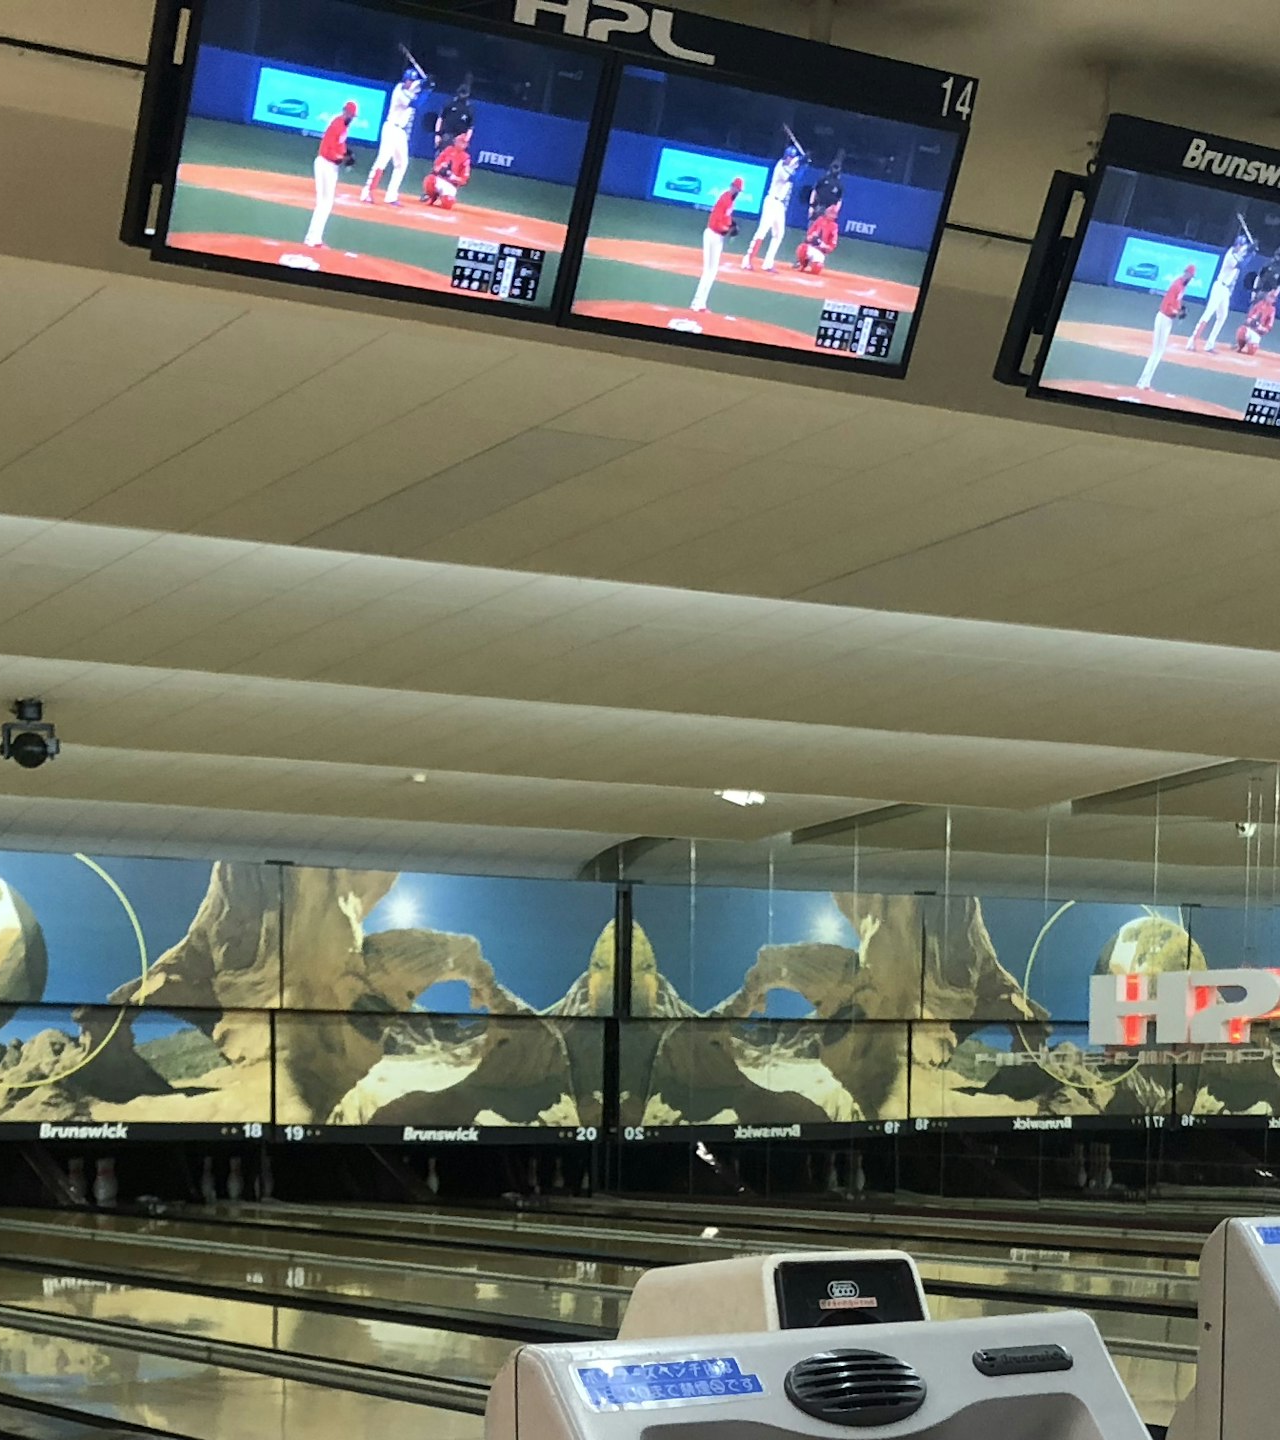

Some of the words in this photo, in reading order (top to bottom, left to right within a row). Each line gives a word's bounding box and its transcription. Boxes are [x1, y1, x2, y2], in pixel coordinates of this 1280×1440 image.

[514, 0, 715, 65] HPL
[940, 76, 974, 121] 14
[39, 1122, 128, 1140] Brunswick
[243, 1122, 263, 1138] 18
[284, 1125, 304, 1142] 19
[403, 1125, 479, 1142] Brunswick
[576, 1126, 598, 1142] 20
